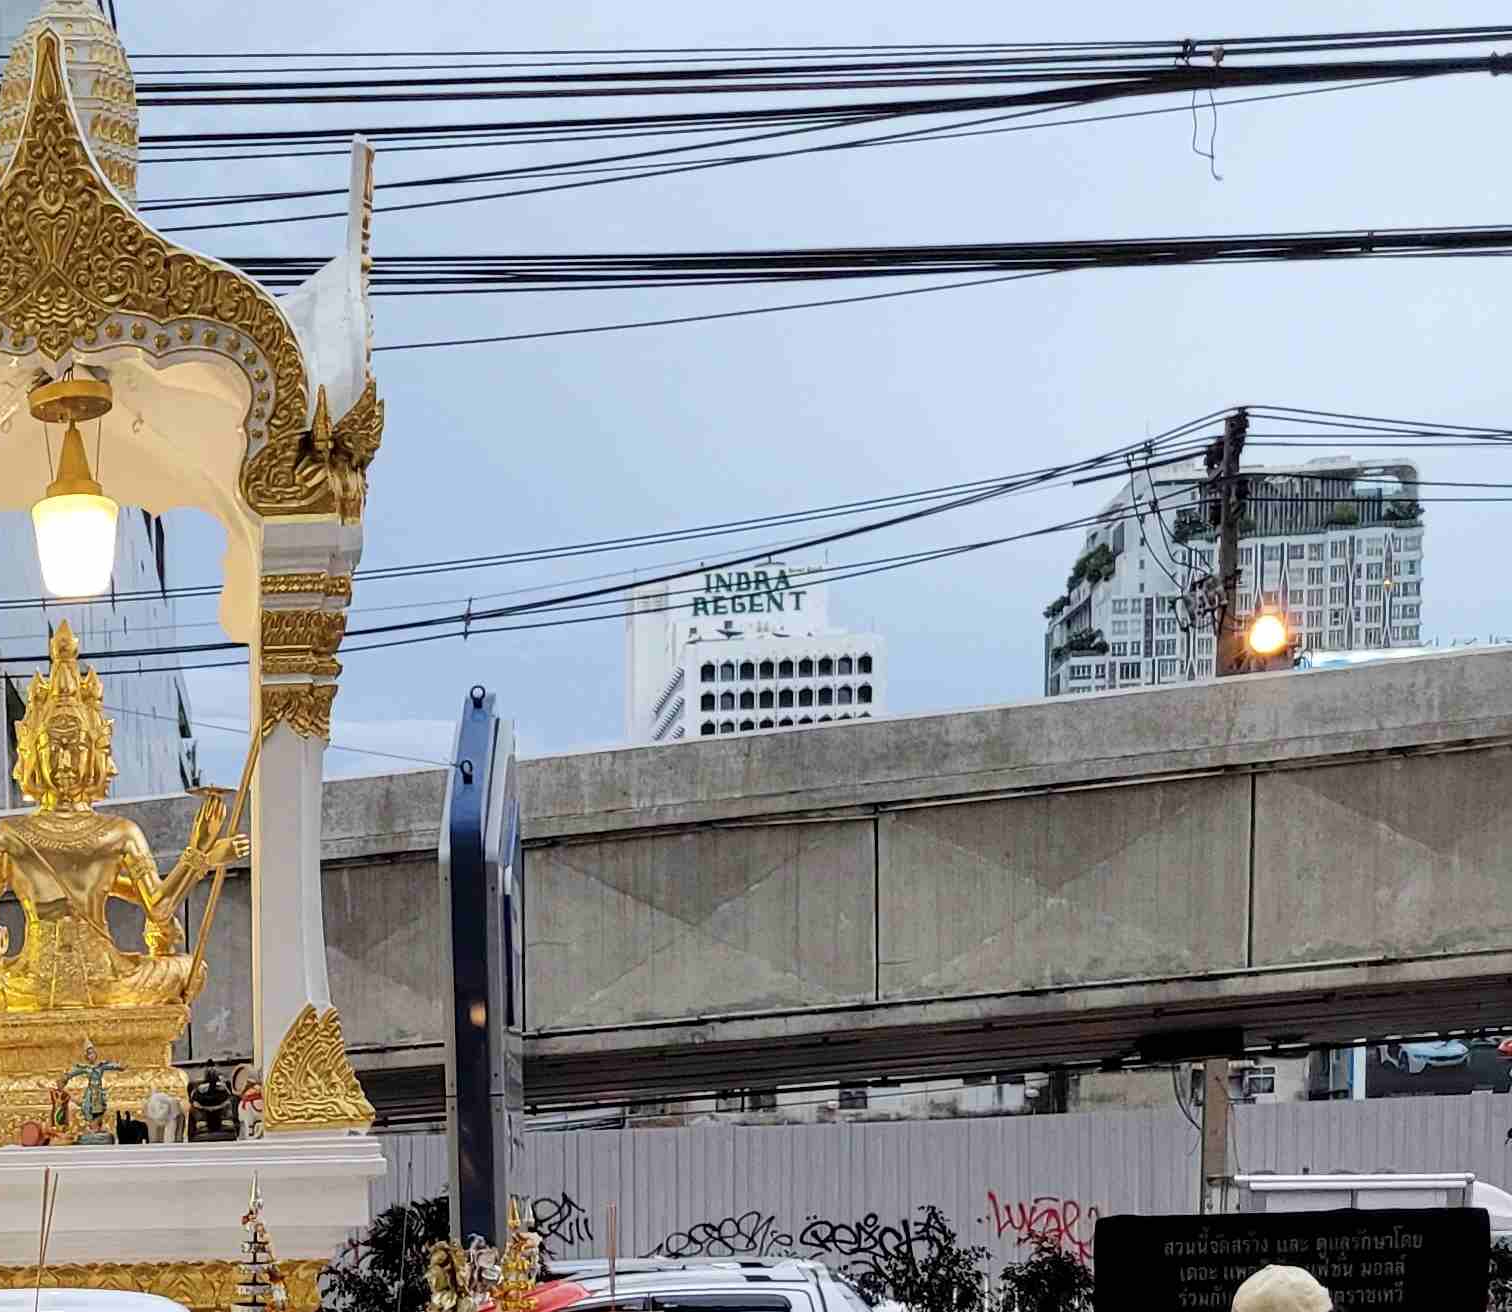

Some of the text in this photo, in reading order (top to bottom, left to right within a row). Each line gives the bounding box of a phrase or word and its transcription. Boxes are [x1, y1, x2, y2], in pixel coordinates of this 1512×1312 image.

[704, 569, 791, 593] INDRA
[692, 591, 806, 616] REGENT
[1277, 1238, 1308, 1253] และ
[1179, 1265, 1217, 1282] เดอะ
